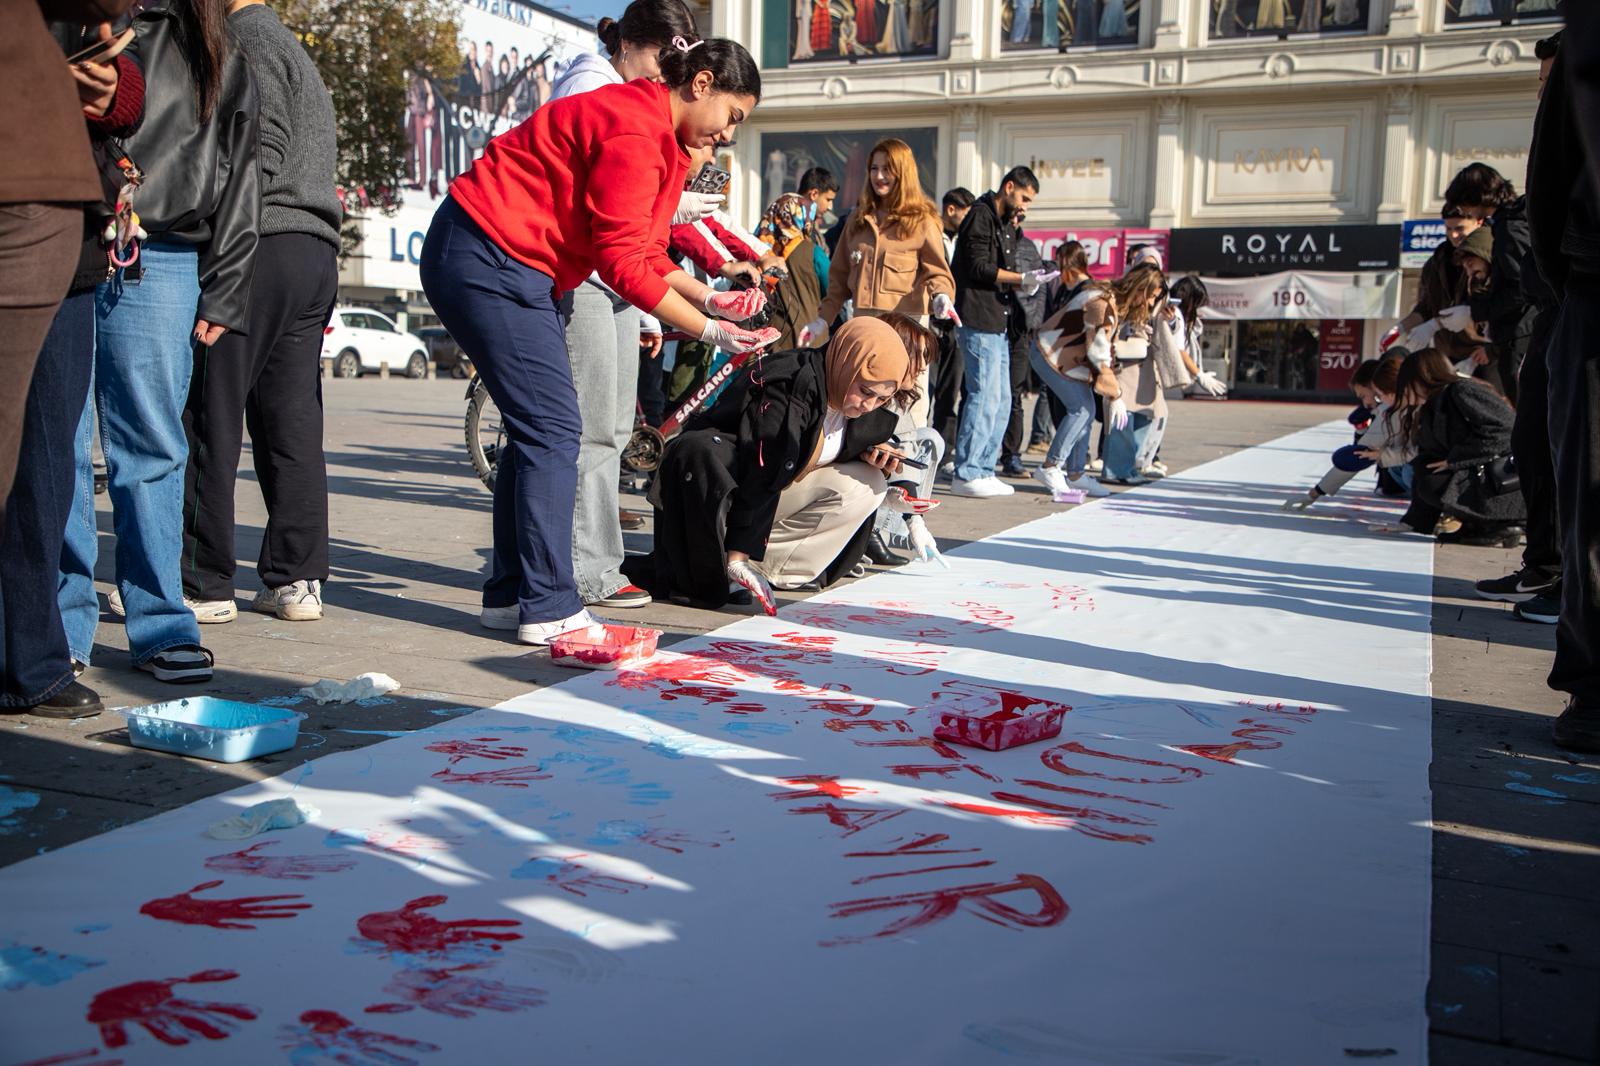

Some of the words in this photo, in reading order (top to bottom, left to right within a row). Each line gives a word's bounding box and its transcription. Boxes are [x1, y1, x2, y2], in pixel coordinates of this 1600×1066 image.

[1221, 233, 1342, 254] ROYAL
[1272, 291, 1306, 306] 190
[675, 362, 734, 423] SALCANO
